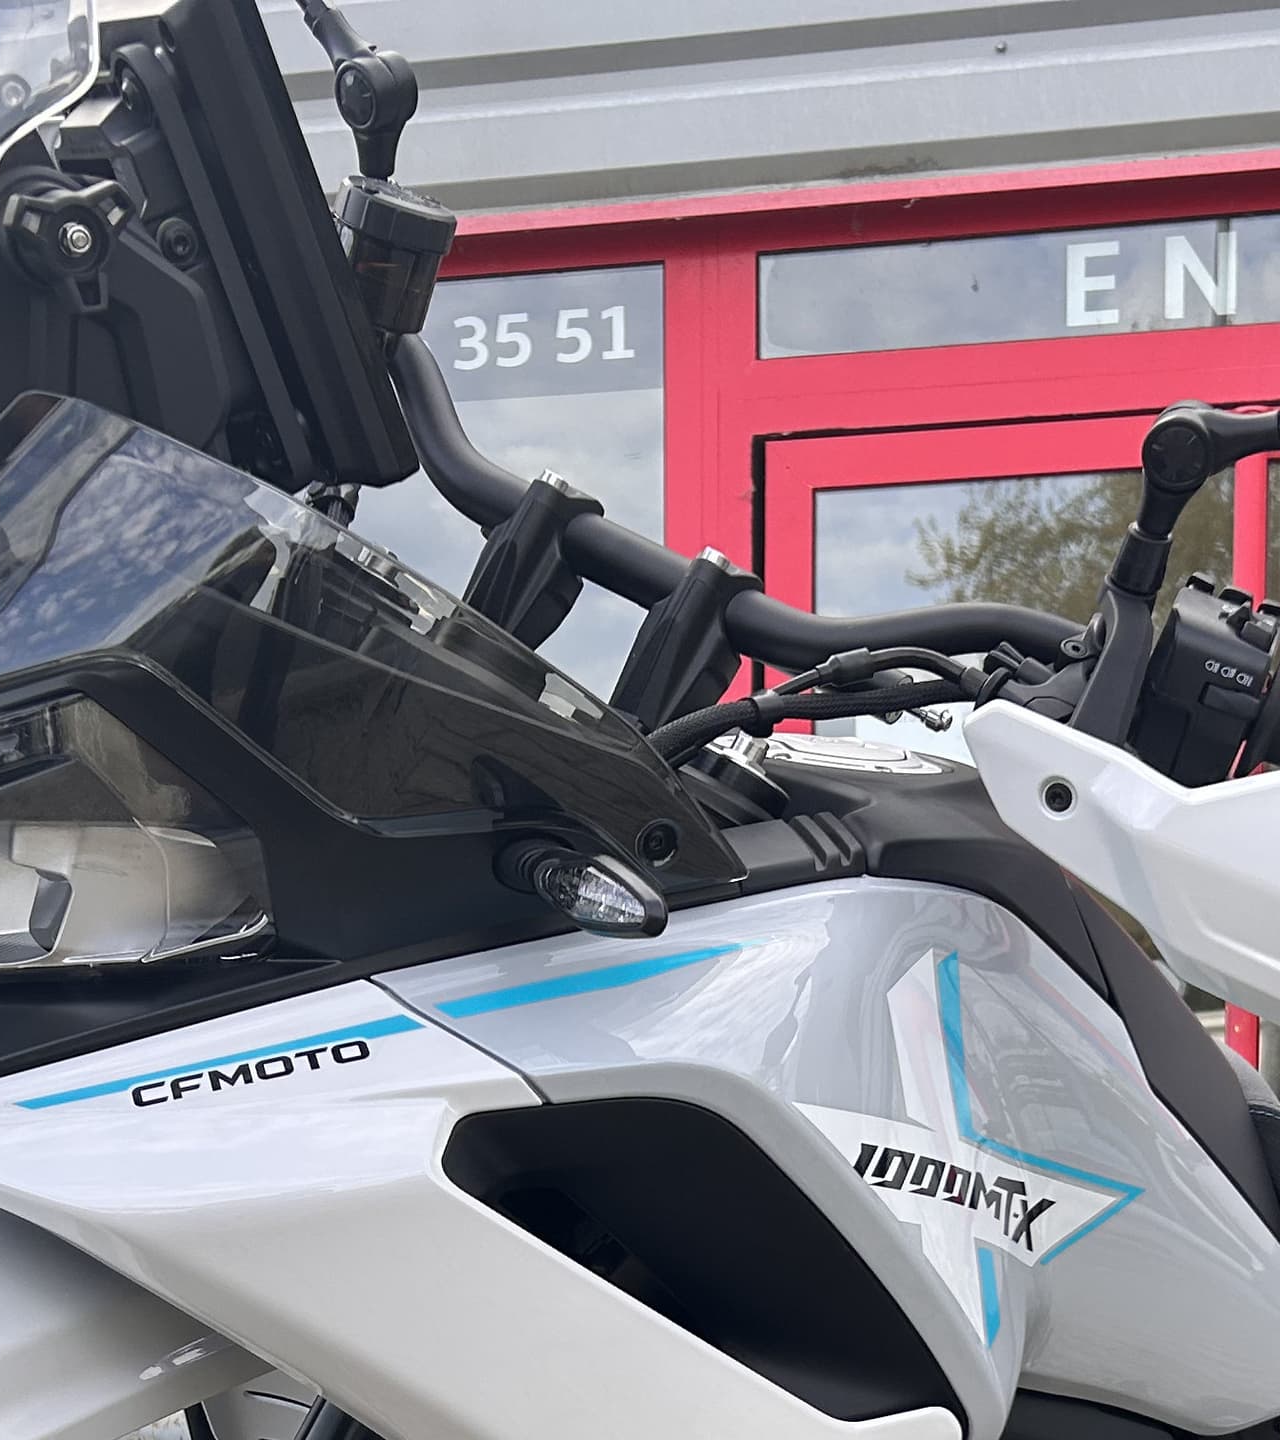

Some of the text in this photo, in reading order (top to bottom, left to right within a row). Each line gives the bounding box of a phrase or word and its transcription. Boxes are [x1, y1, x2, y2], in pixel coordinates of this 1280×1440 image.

[452, 305, 636, 371] 35 51
[131, 1039, 370, 1108] CFMOTO
[852, 1142, 1057, 1252] 1000MT-X
